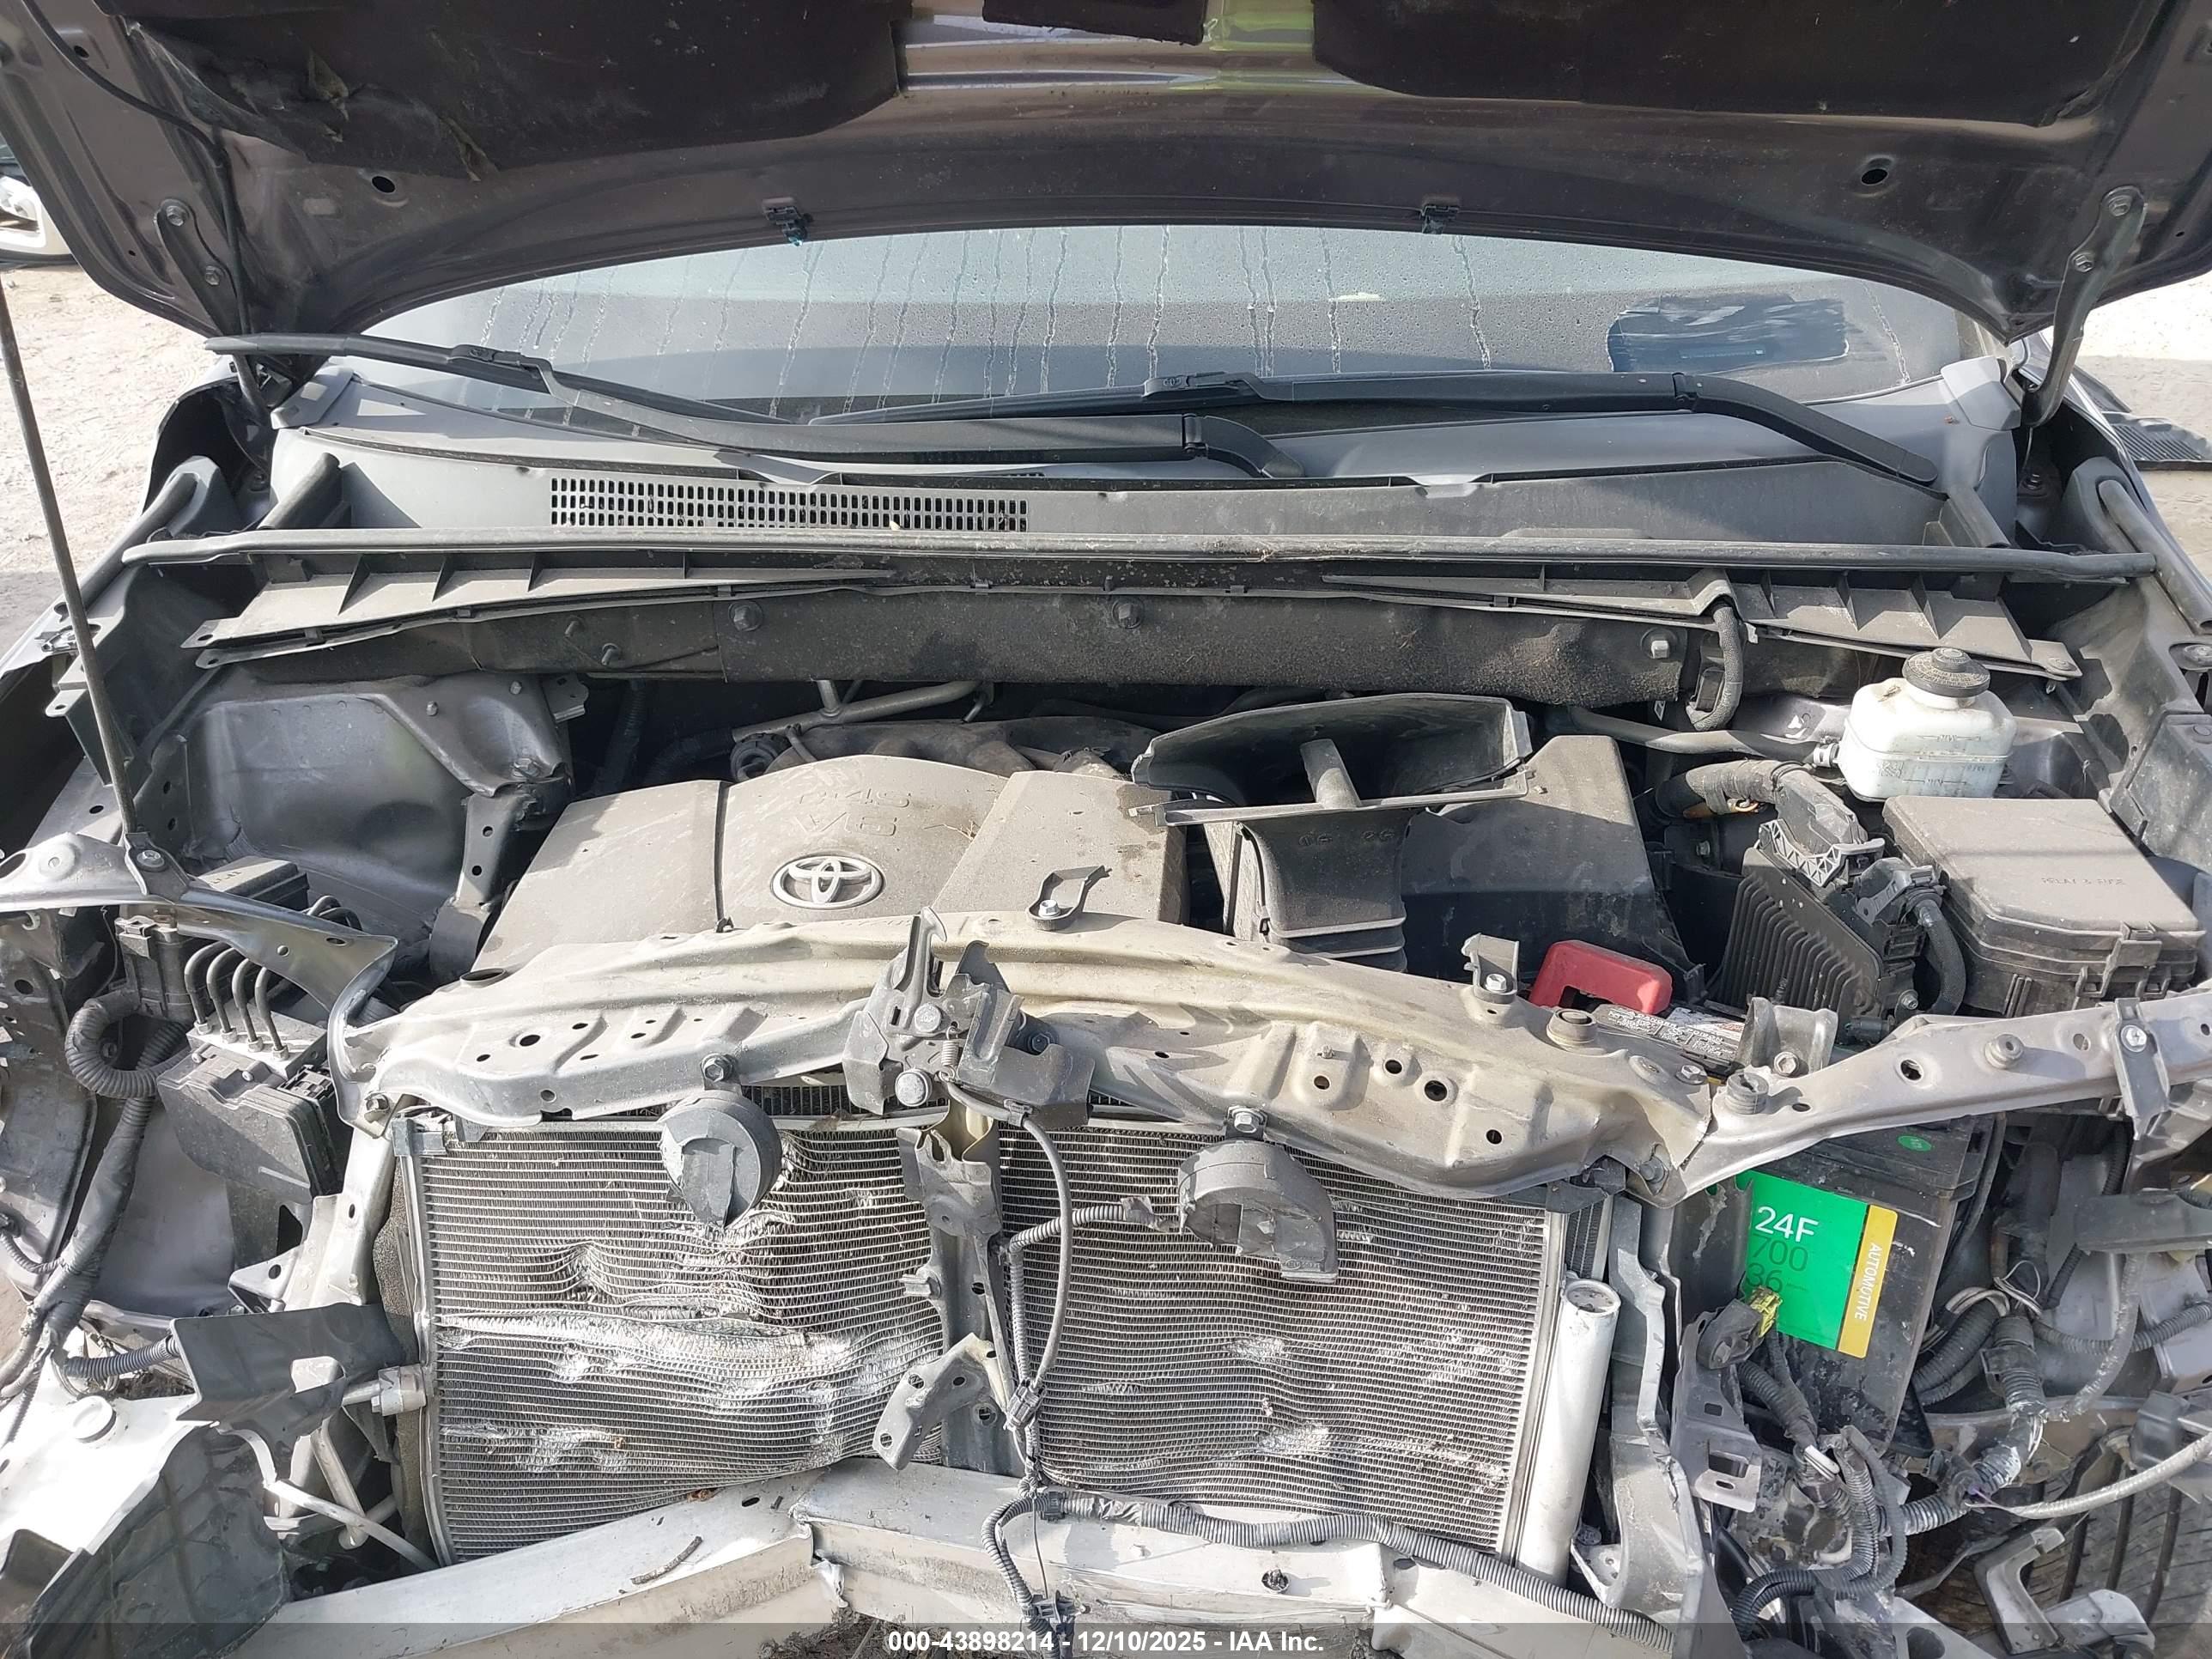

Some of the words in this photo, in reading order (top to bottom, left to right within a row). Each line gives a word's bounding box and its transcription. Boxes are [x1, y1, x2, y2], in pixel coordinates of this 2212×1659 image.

[1754, 1206, 1820, 1243] 24F
[1752, 1233, 1808, 1272] 700
[1747, 1262, 1784, 1293] 36
[1854, 1242, 1883, 1322] AUTOMOTIVE
